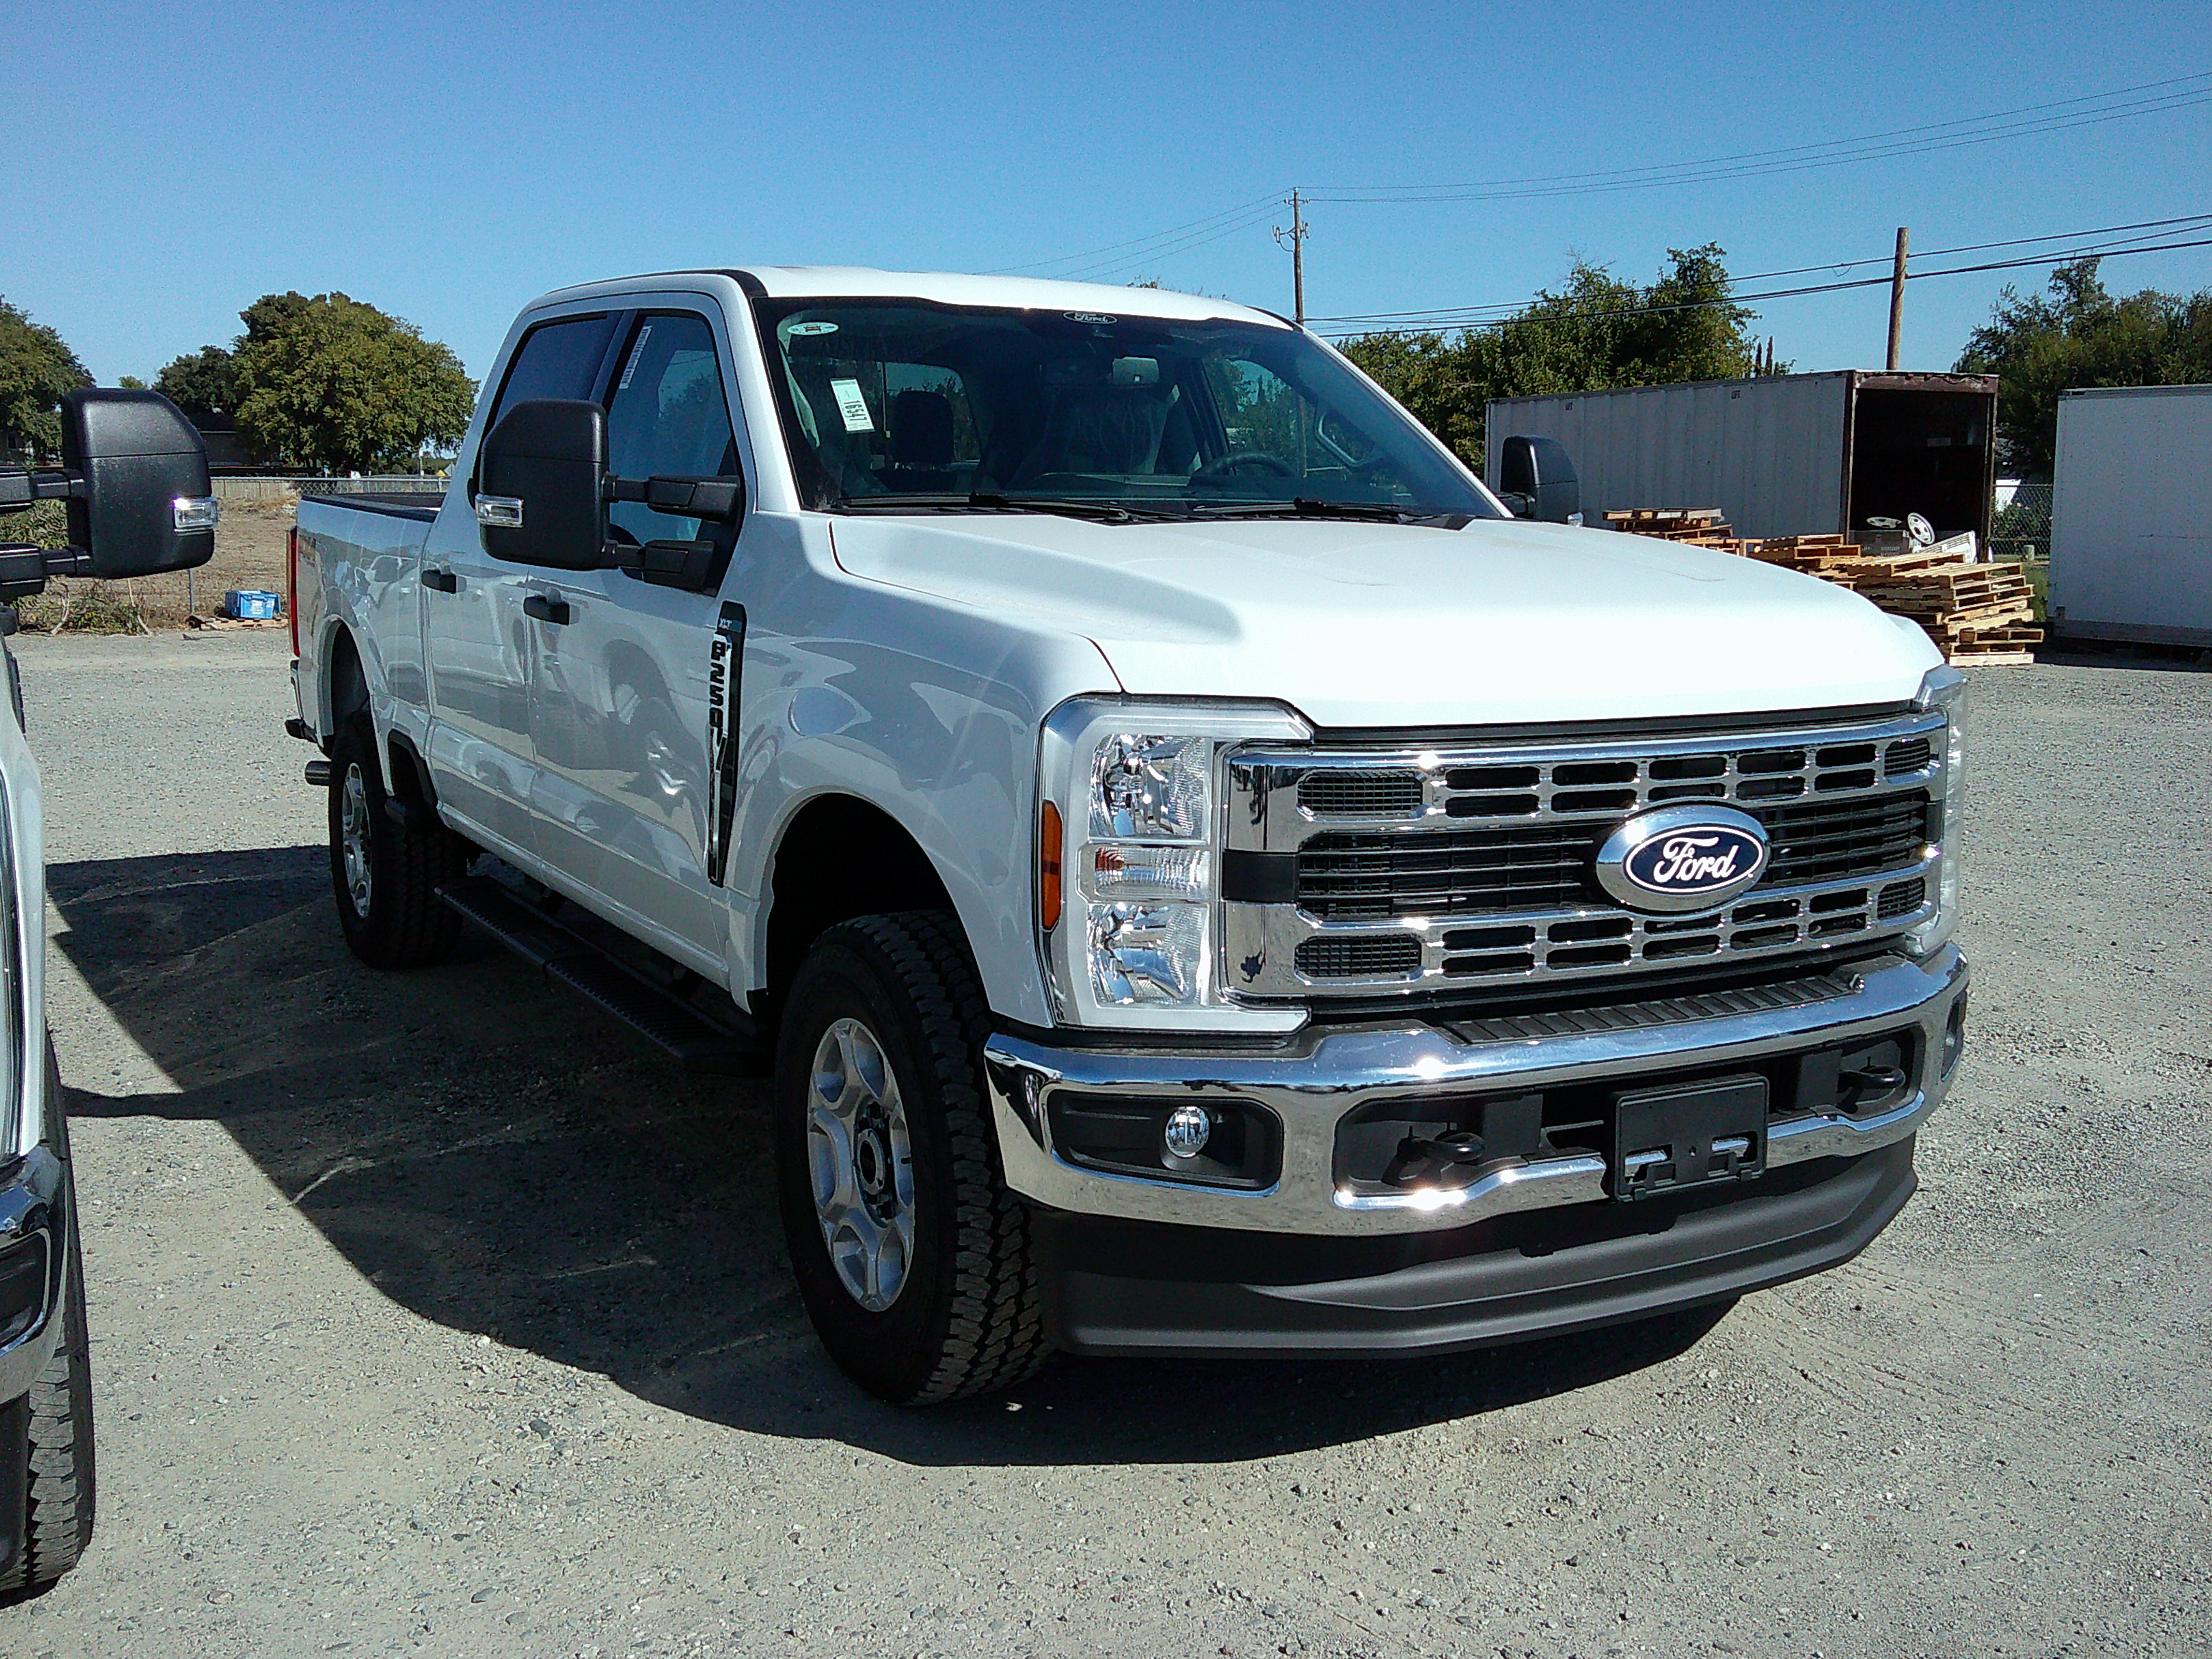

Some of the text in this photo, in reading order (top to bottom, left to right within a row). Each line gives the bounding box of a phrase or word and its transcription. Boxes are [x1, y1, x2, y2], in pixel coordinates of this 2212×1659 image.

[1074, 312, 1108, 322] Ford
[719, 617, 732, 630] XLT
[1653, 836, 1739, 883] Ford
